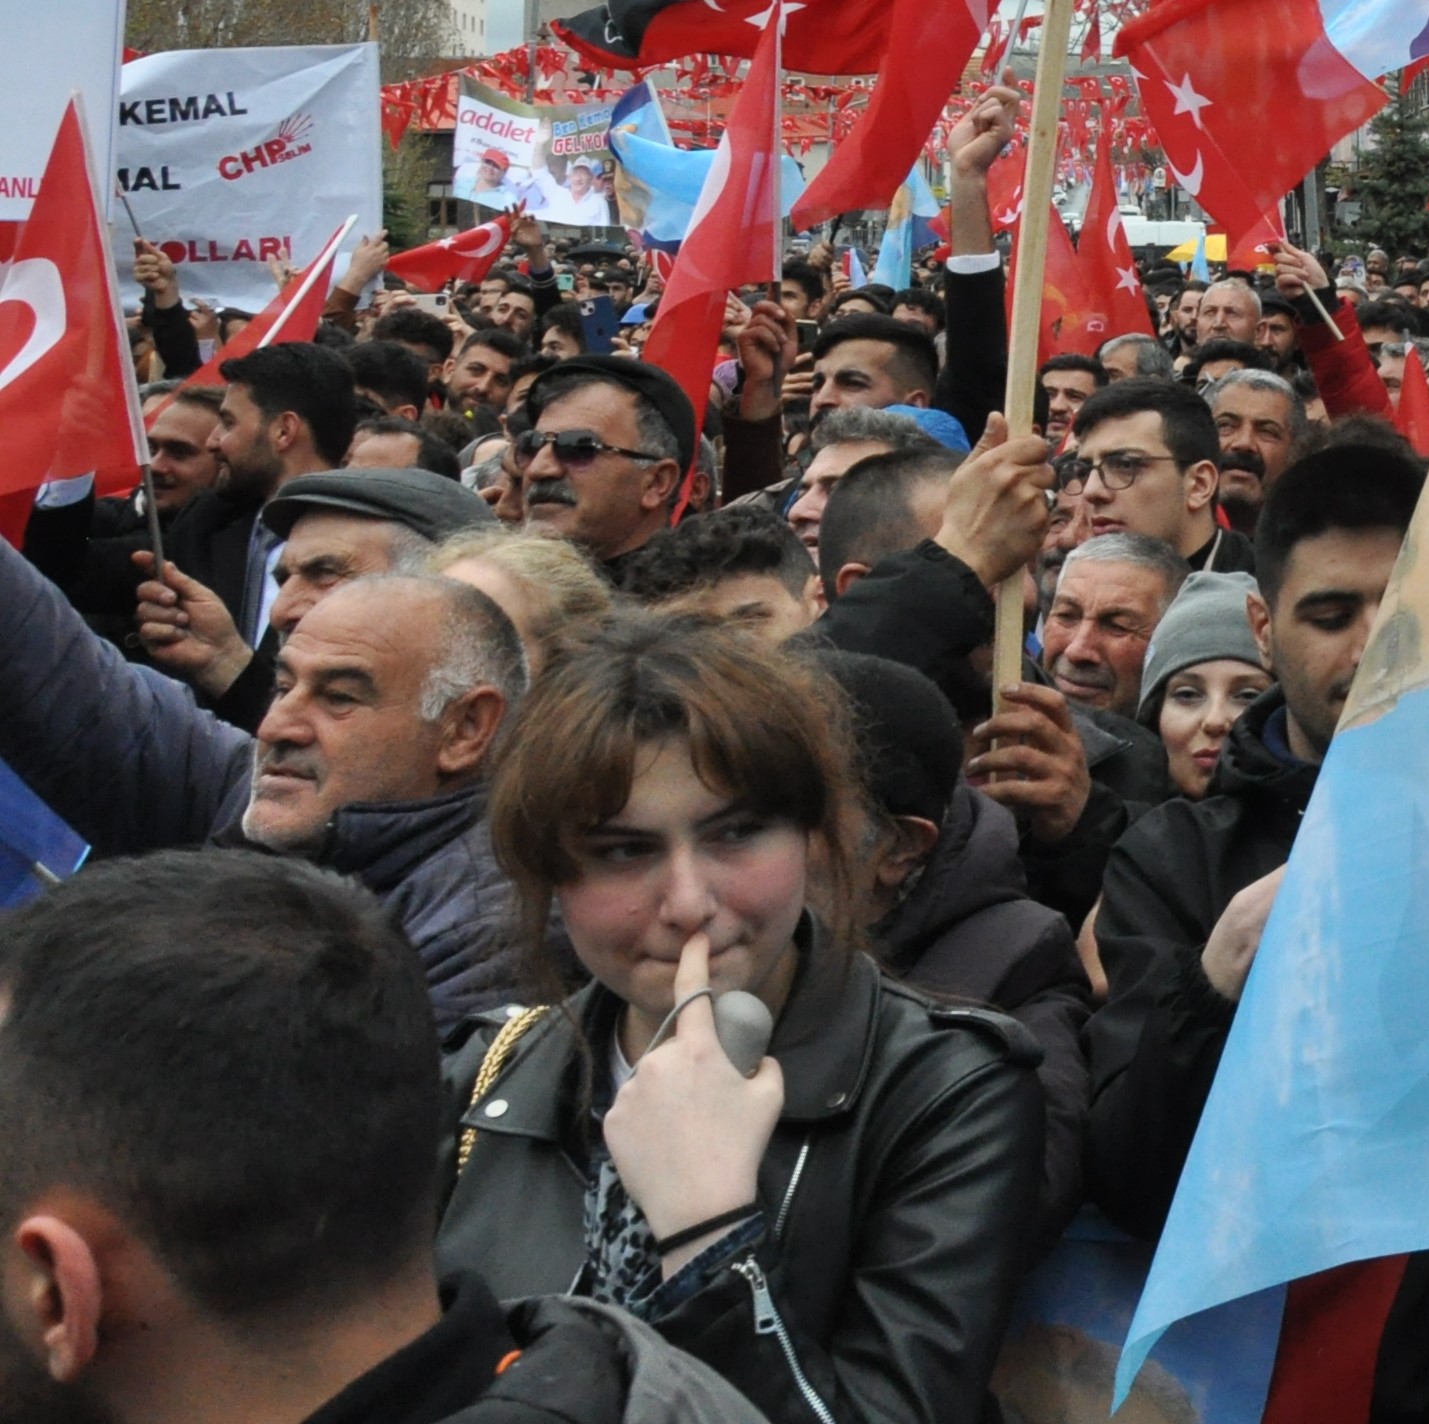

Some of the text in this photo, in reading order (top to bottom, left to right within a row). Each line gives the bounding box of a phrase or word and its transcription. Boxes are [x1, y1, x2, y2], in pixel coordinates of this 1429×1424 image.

[119, 91, 248, 126] KEMAL
[459, 108, 536, 144] adalet
[218, 138, 287, 181] CHP
